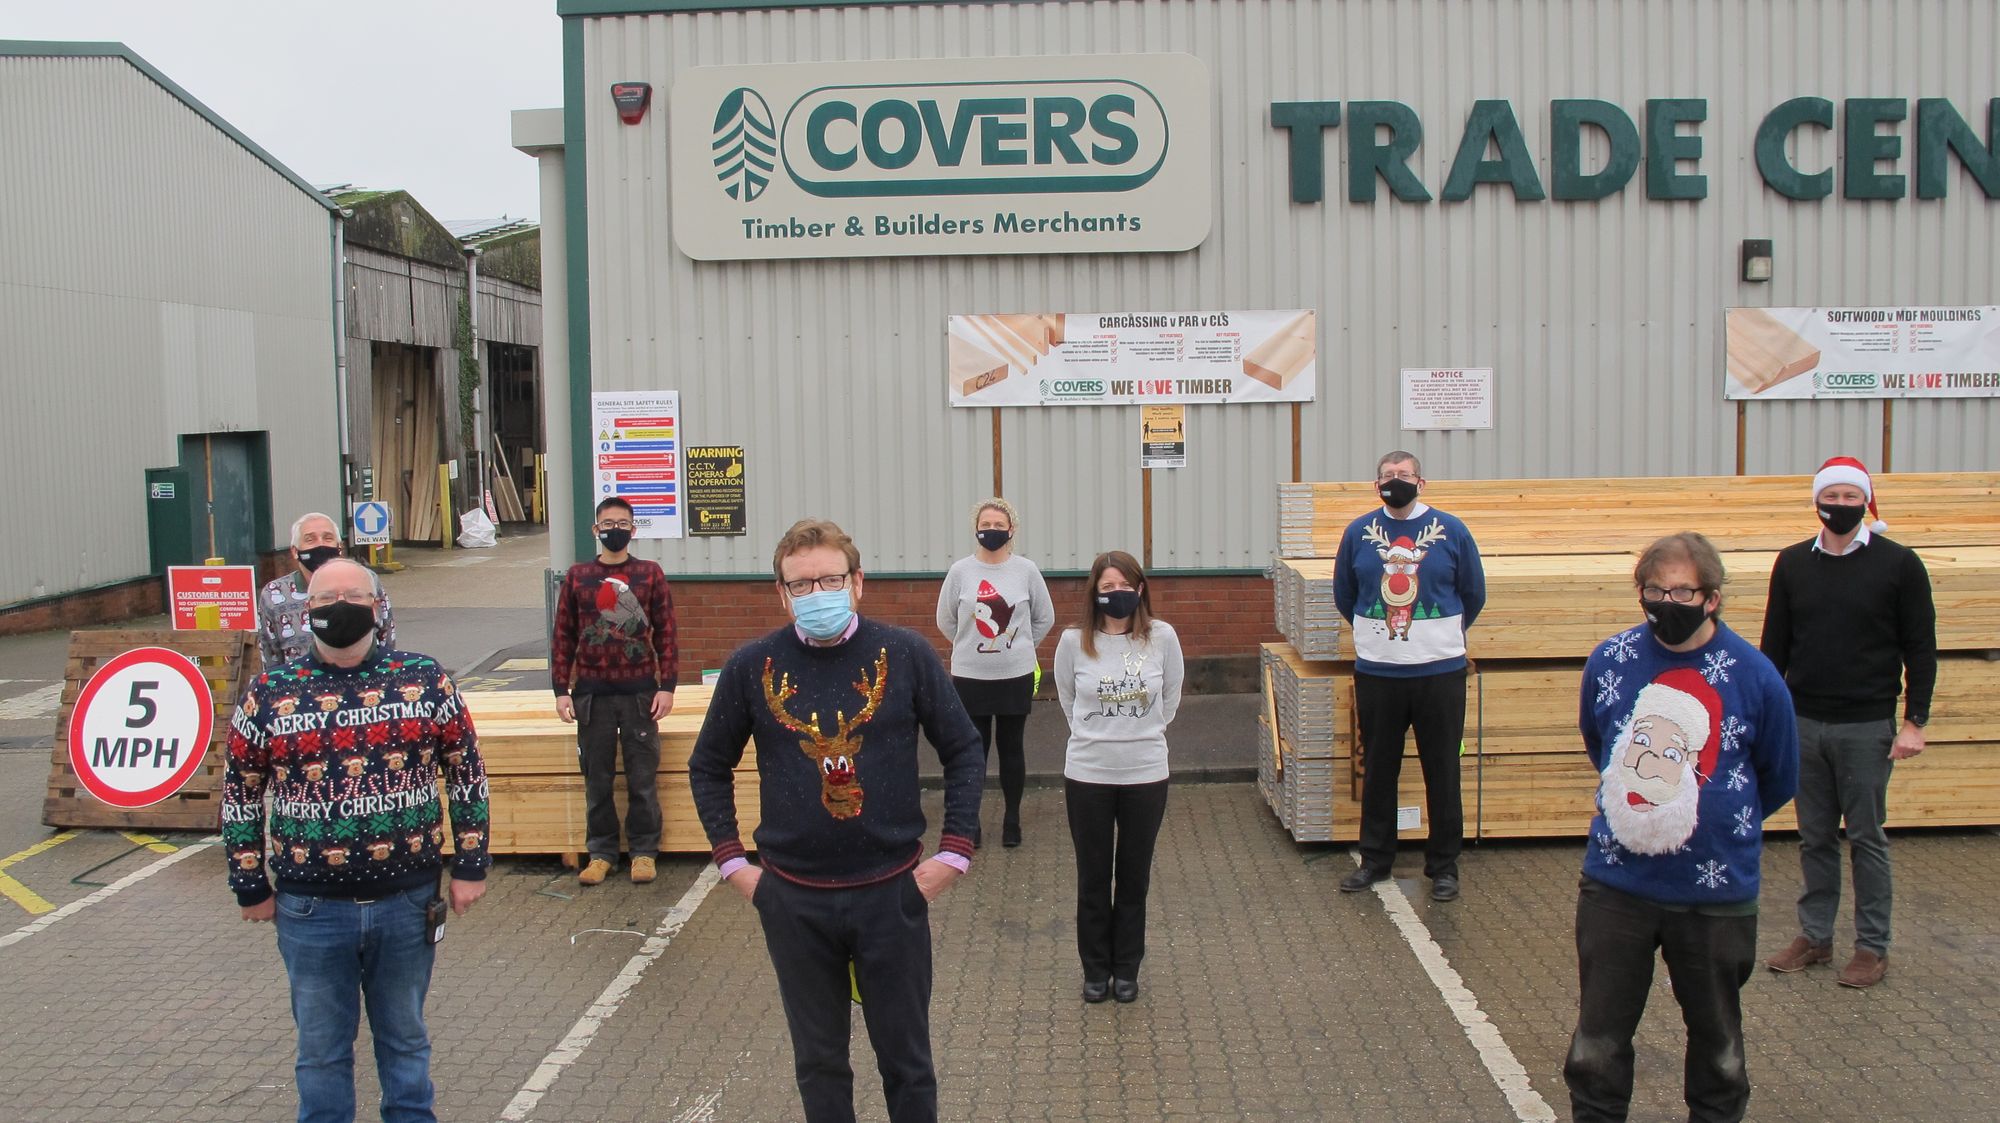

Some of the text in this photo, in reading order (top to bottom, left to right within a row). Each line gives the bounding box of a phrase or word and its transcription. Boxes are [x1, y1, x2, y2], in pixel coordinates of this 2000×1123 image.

[807, 94, 1139, 171] COVERS
[1271, 98, 1707, 202] TRADE
[742, 210, 1141, 239] Timber & Builders Merchants
[1099, 316, 1167, 328] CARCASSING
[1178, 315, 1199, 327] PAR
[1209, 314, 1229, 327] CLS
[1827, 310, 1885, 322] SOFTWOOD
[1896, 310, 1917, 322] MDF
[1920, 309, 1981, 321] MOULDINGS
[1054, 380, 1103, 392] COVERS
[1111, 380, 1134, 395] WE
[1176, 379, 1232, 394] TIMBER
[1827, 374, 1875, 385] COVERS
[1883, 374, 1905, 388] WE
[1946, 373, 2000, 388] TIMBER
[687, 448, 744, 458] WARNING
[688, 470, 724, 478] CAMERAS
[125, 681, 160, 728] 5
[266, 700, 435, 737] MERRY CHRISTMAS
[92, 738, 180, 769] MPH
[280, 799, 336, 820] MERRY
[340, 788, 430, 818] CHRISTMAS
